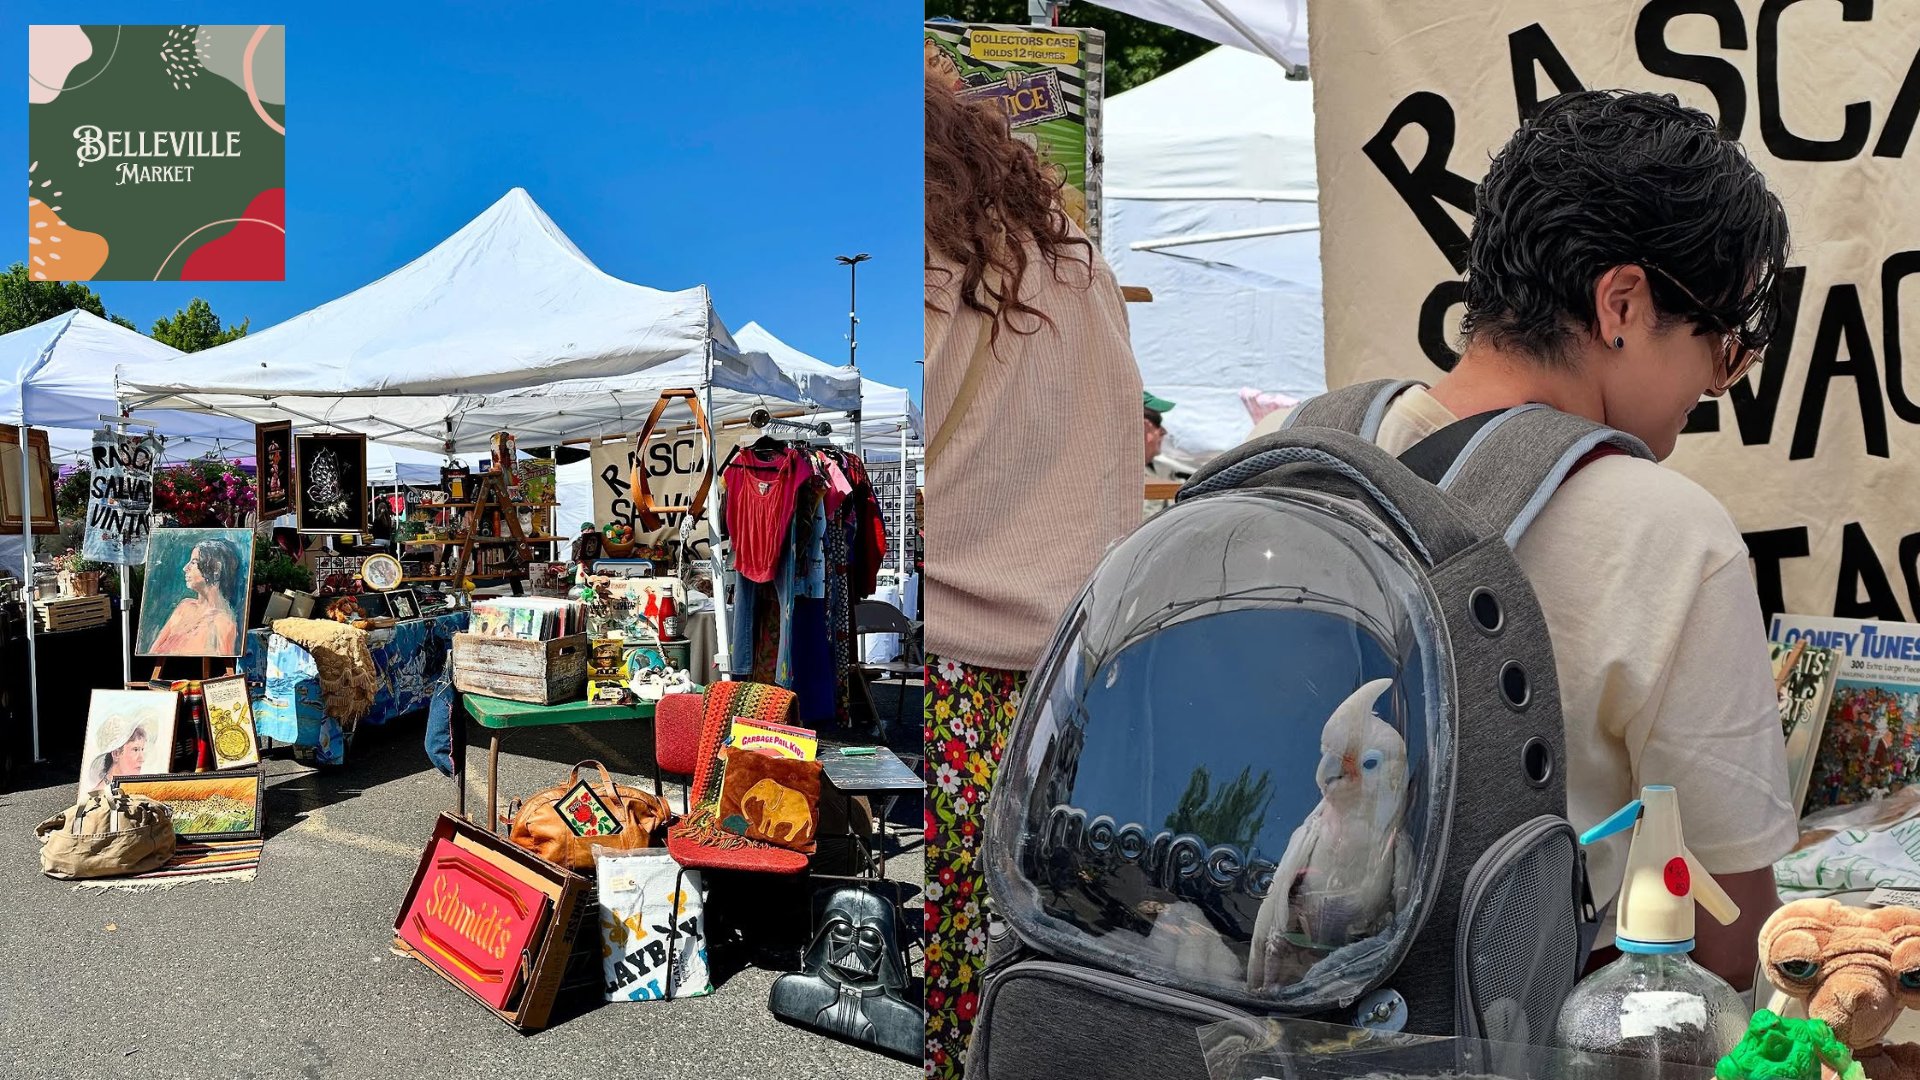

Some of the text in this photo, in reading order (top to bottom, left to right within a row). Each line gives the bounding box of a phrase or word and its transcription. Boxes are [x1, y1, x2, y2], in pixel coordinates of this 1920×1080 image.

[973, 34, 1076, 48] COLLECTORS CASE
[983, 48, 1066, 60] HOLDS 12 FIGURES
[1771, 619, 1860, 657] LOONEY
[1850, 660, 1865, 670] 300
[1866, 661, 1883, 671] Extra
[1884, 663, 1903, 674] Large
[742, 735, 805, 759] GARBAGE PAIL KIDS
[426, 873, 512, 960] Schmidt's
